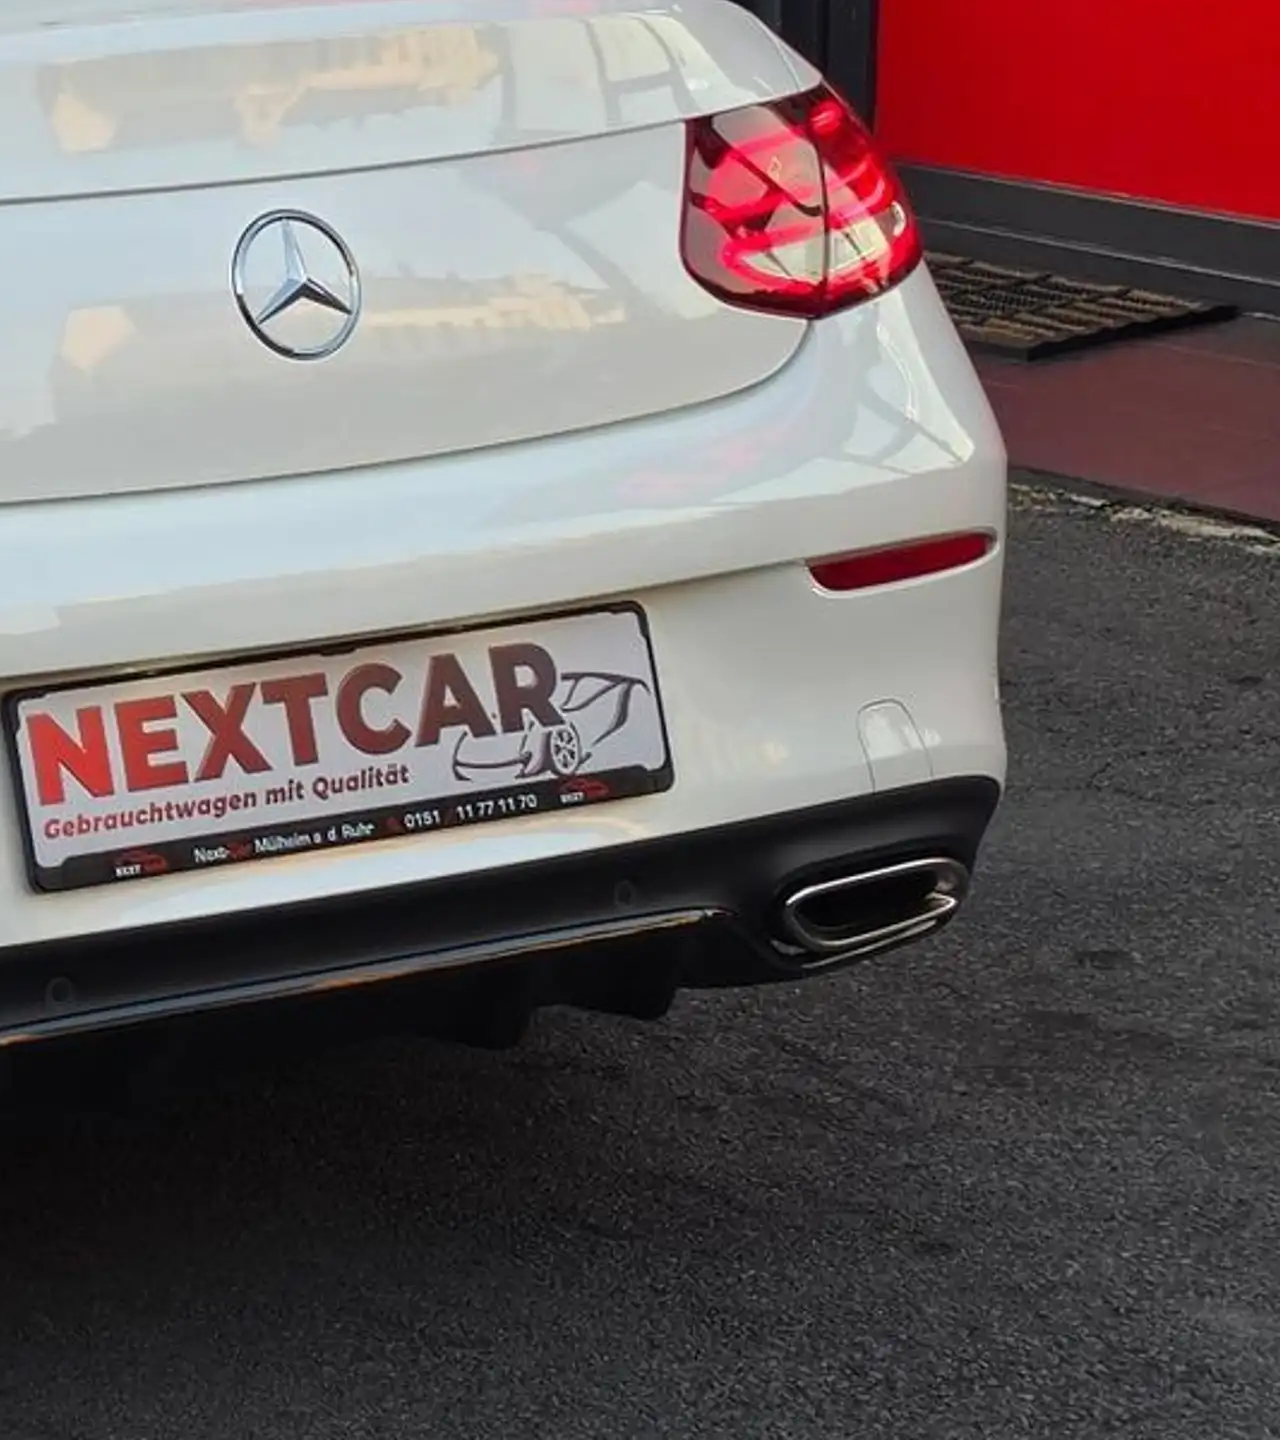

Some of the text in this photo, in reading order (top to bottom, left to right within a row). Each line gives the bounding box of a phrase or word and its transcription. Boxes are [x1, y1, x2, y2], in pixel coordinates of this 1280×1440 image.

[25, 643, 566, 806] NEXTCAR
[44, 764, 410, 840] Gebrauchtwagen mit Qualität
